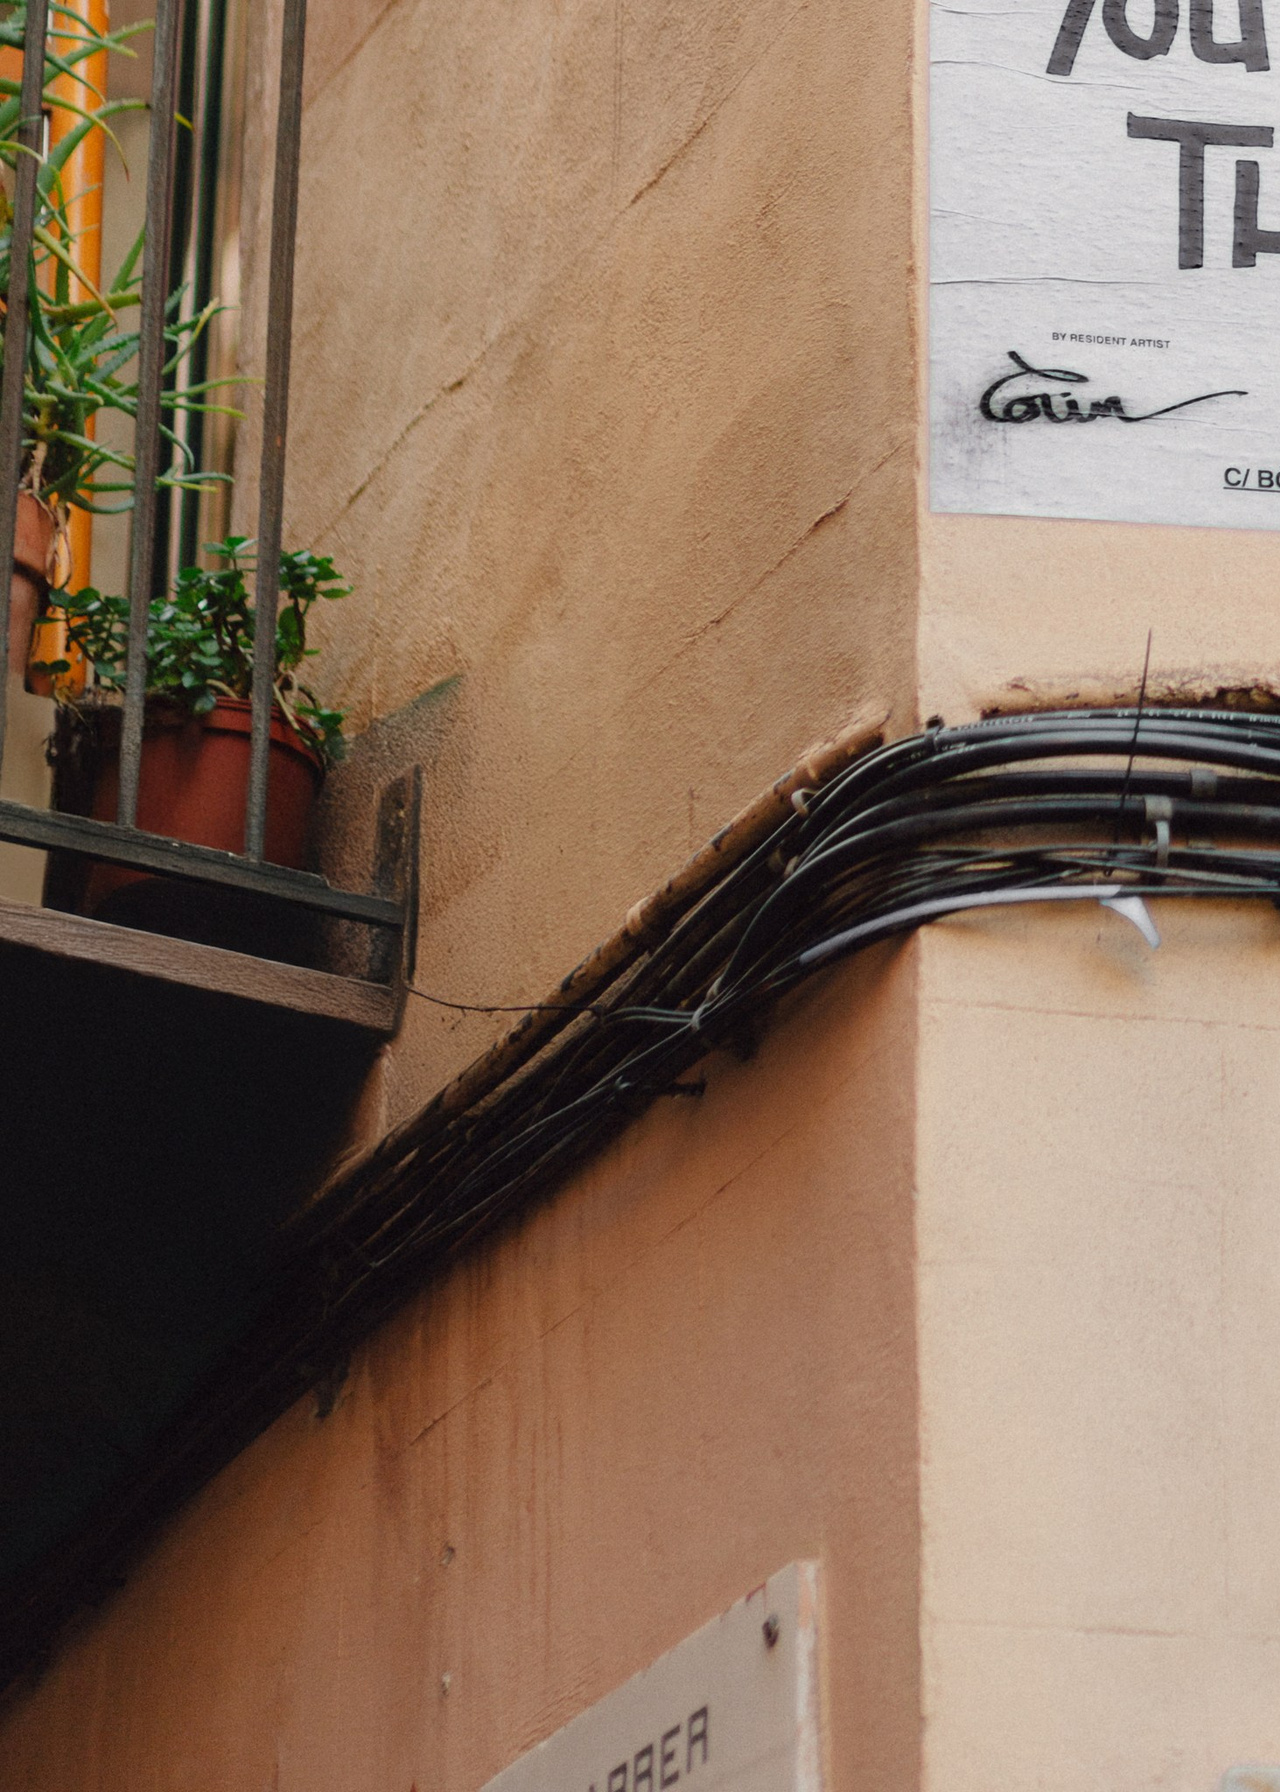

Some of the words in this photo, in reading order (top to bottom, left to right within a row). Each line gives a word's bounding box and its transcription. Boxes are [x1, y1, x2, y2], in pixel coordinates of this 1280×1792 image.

[1051, 332, 1067, 342] BY
[1069, 333, 1127, 347] RESIDENT
[1129, 337, 1171, 350] ARTIST
[1223, 466, 1251, 488] C/
